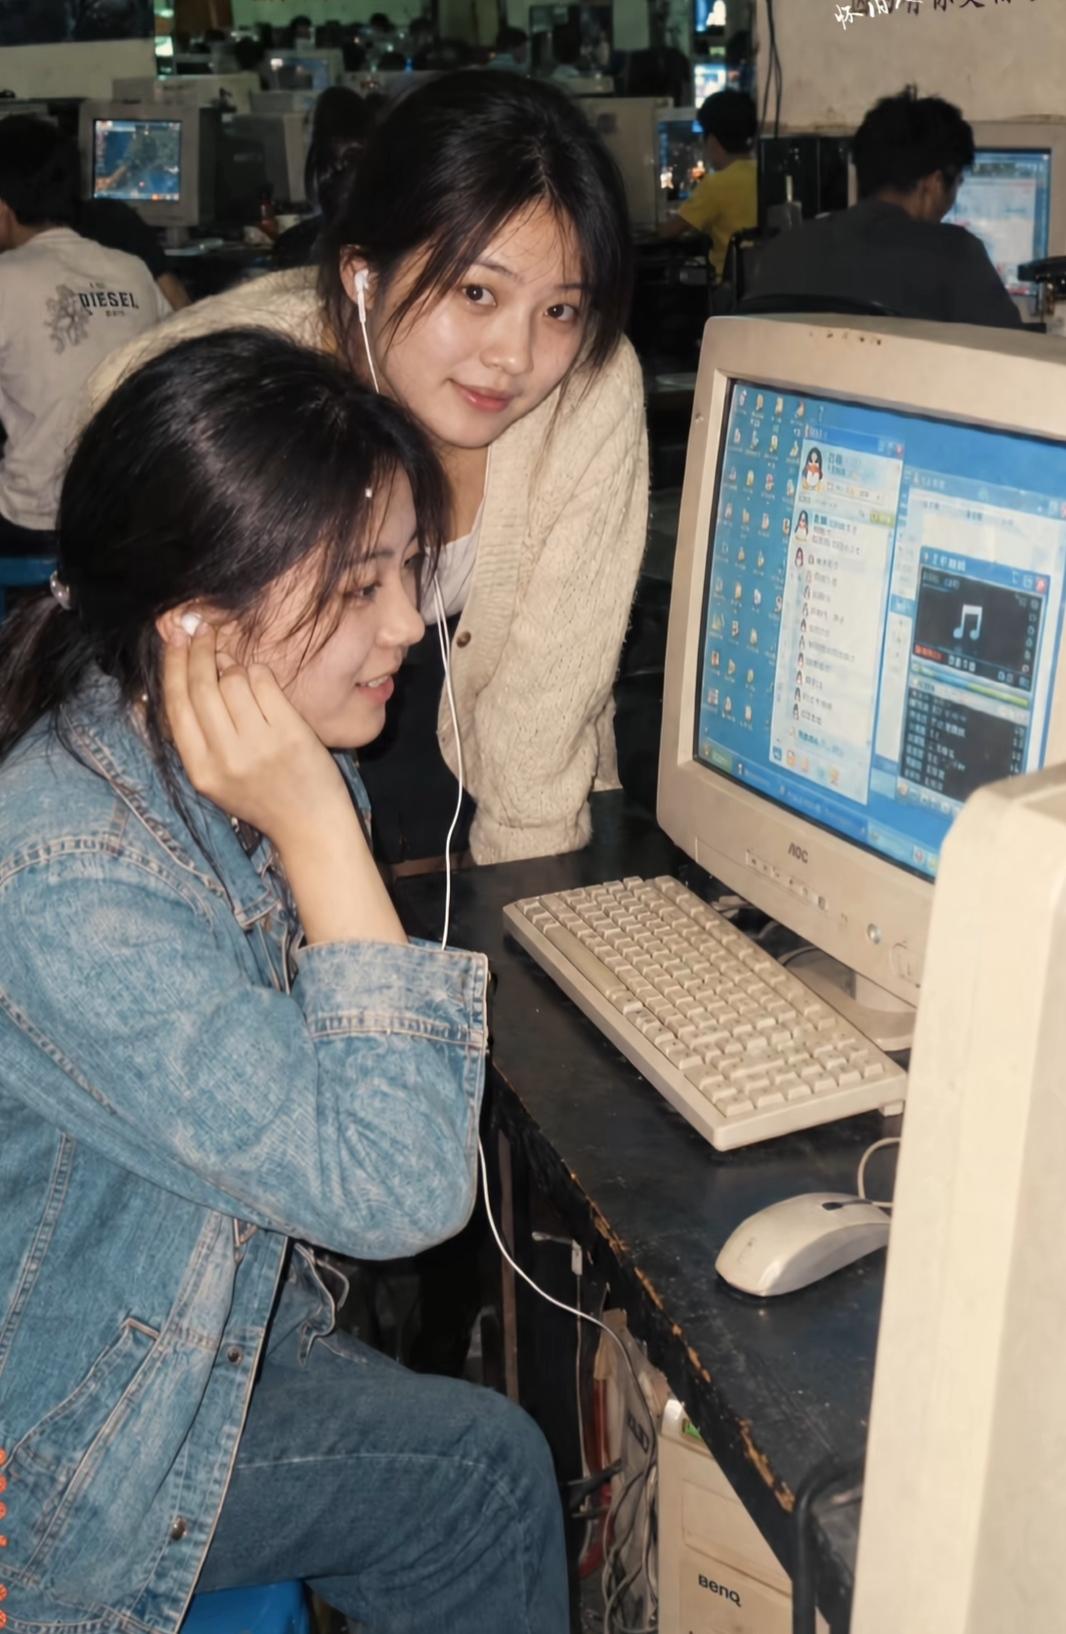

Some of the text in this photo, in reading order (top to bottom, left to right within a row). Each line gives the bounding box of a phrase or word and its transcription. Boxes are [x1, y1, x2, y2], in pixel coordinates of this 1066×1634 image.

[78, 291, 140, 309] DIESEL
[788, 842, 809, 864] AOC
[698, 1573, 742, 1608] BenQ
